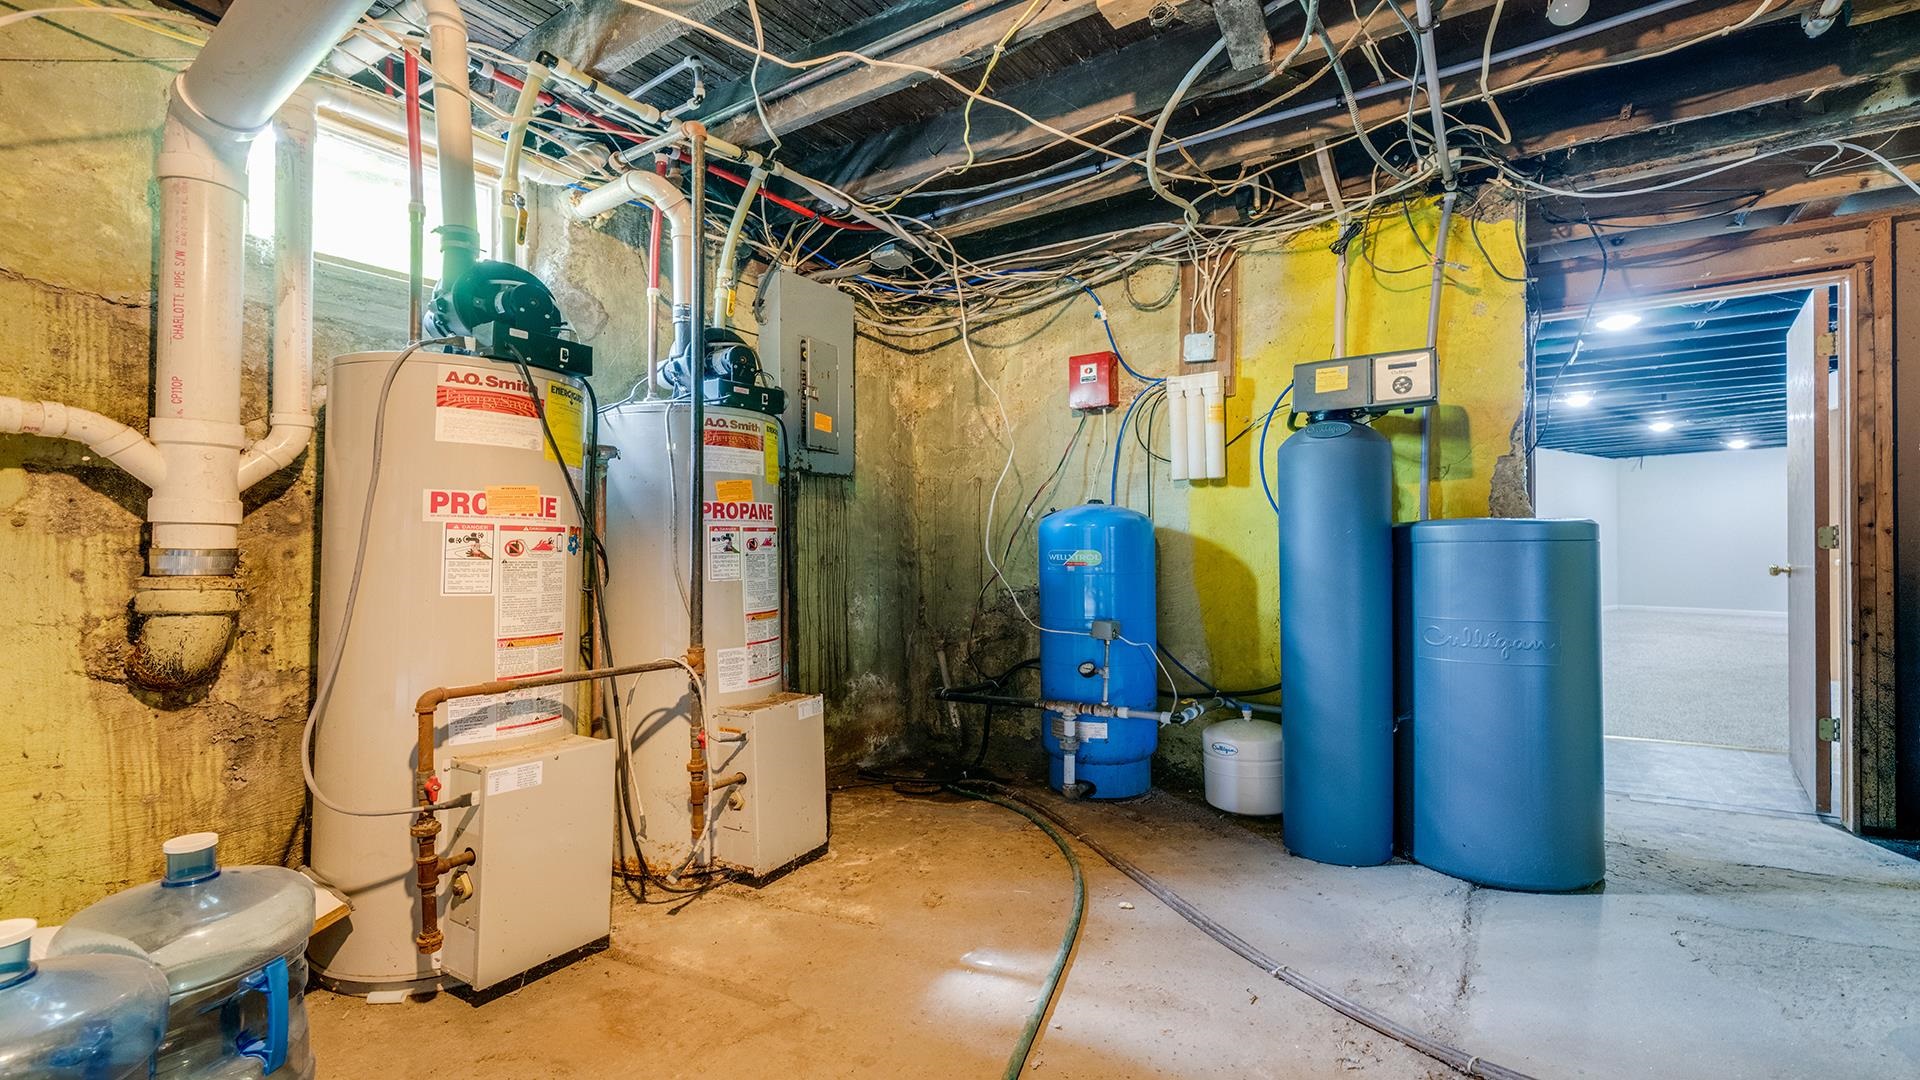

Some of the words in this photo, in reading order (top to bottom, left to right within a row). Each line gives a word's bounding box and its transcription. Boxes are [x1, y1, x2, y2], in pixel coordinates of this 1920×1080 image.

[174, 250, 186, 267] S/W
[173, 270, 185, 289] PIPE
[172, 292, 185, 341] CHARLOTTE
[445, 371, 483, 386] A.O.
[704, 417, 729, 428] A.O.
[730, 420, 760, 432] Smith
[430, 491, 557, 518] PROE
[703, 502, 773, 520] PROPANE
